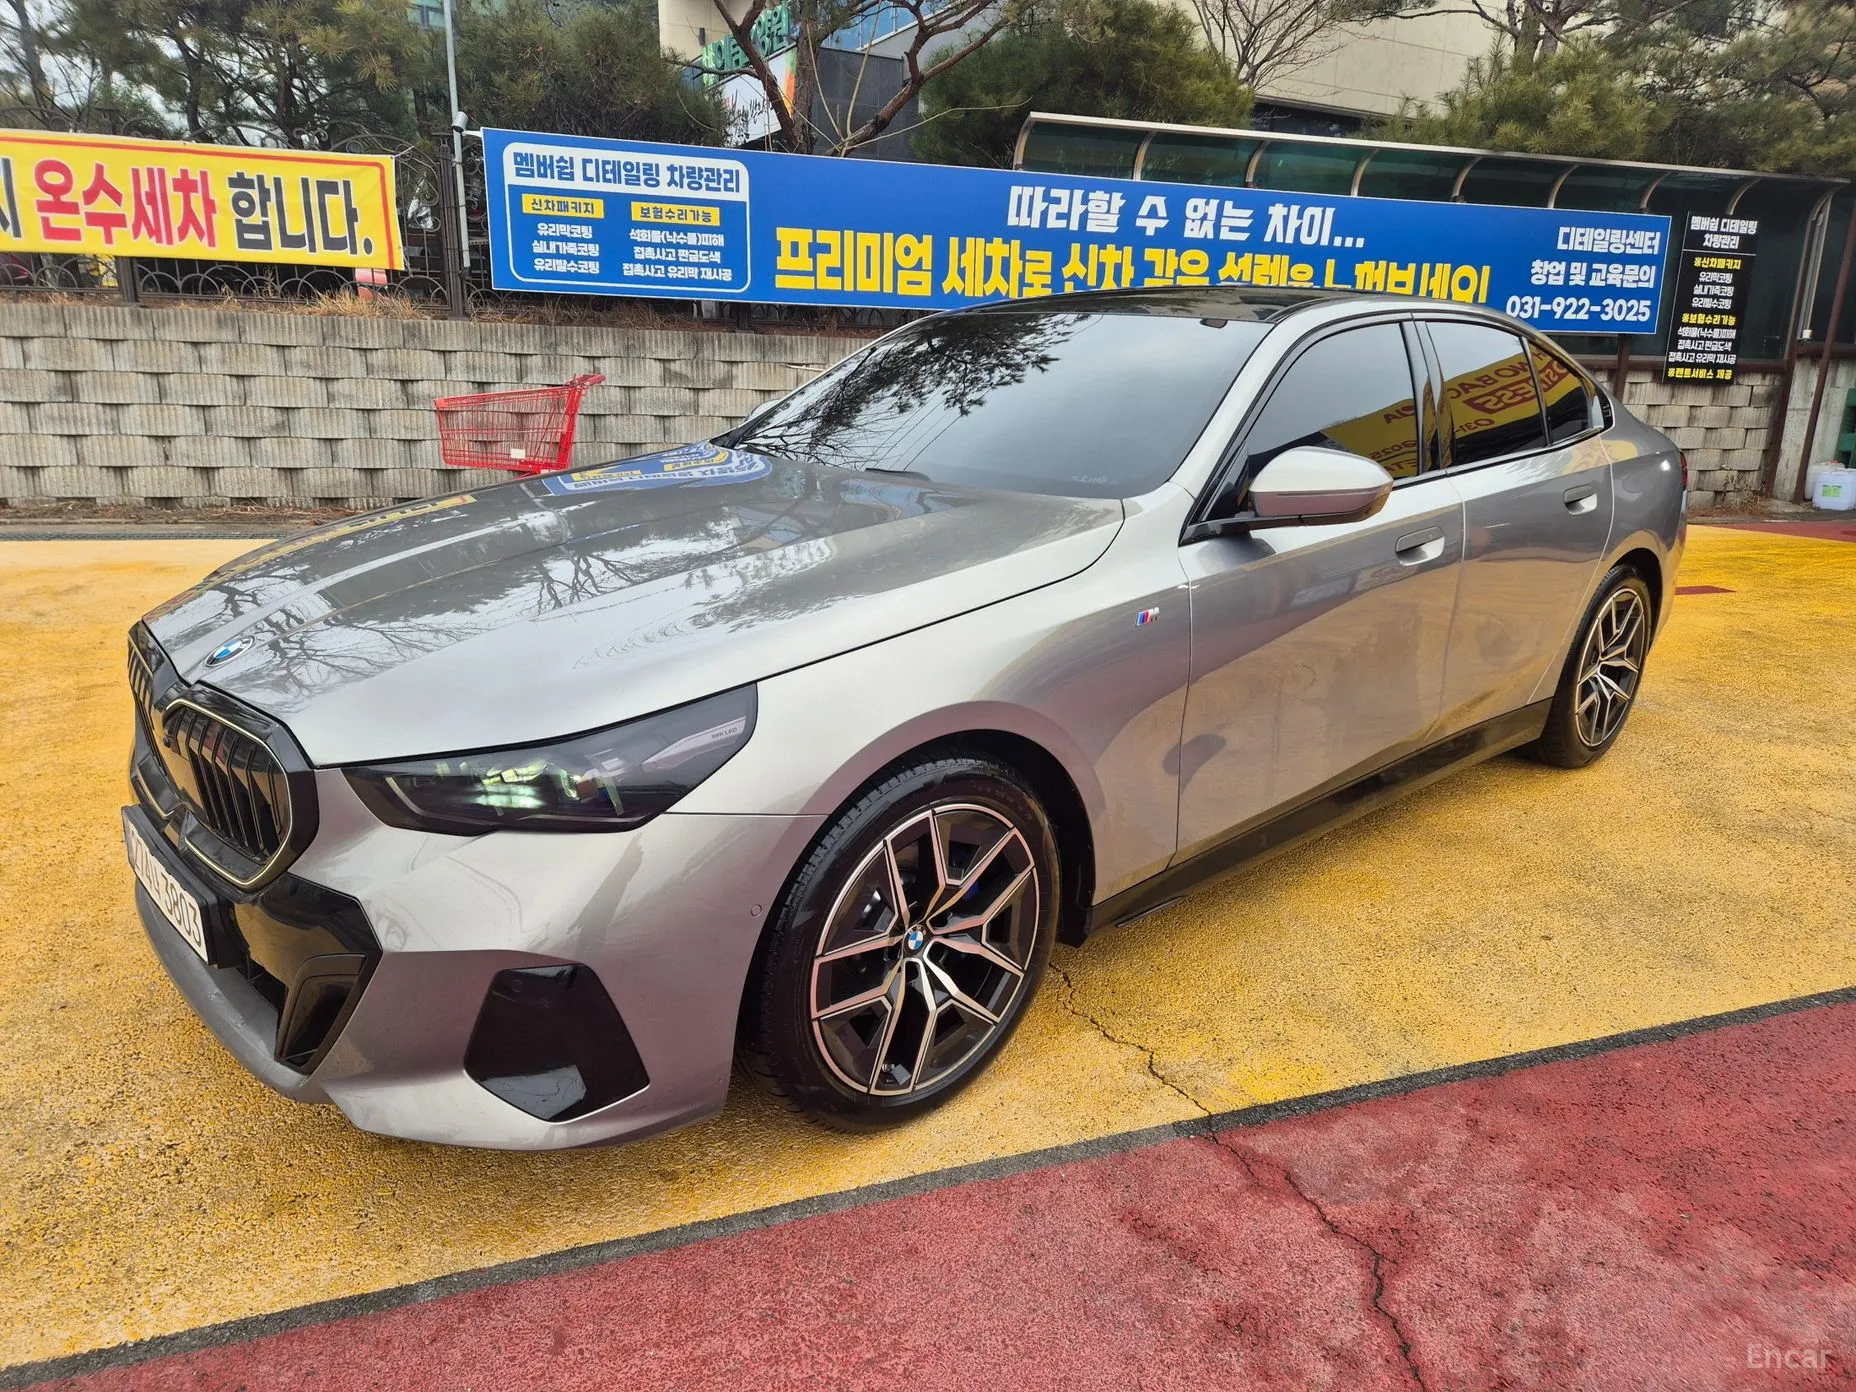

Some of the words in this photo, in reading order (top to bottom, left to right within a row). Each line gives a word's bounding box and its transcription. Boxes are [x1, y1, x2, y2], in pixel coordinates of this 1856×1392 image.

[513, 152, 575, 182] 멤버쉽
[582, 158, 660, 188] 디테일링
[666, 164, 740, 193] 차량관리
[34, 159, 218, 248] 온수세차
[227, 171, 374, 256] 합니다.
[531, 198, 594, 215] 신차패키지
[640, 206, 712, 223] 보험수리가능
[1007, 185, 1126, 233] 따라할
[1135, 196, 1169, 236] 수
[1184, 198, 1257, 241] 없는
[1264, 203, 1365, 248] 차이...
[537, 222, 593, 239] 유리막코팅
[1690, 216, 1720, 232] 멤버쉽
[1720, 218, 1758, 234] 디테일링
[531, 240, 600, 257] 실내가죽코팅
[1557, 226, 1661, 255] 디테일링센터
[1703, 233, 1740, 249] 차량관리
[633, 246, 677, 261] 접촉사고
[677, 249, 721, 264] 판금도색
[775, 227, 933, 296] 프리미엄
[942, 236, 1052, 298] 세차로
[622, 263, 665, 278] 접촉사고
[667, 266, 698, 280] 유리막
[701, 268, 732, 281] 재시공
[1531, 259, 1566, 286] 창업
[1569, 262, 1587, 286] 및
[1589, 263, 1656, 288] 교육문의
[1506, 295, 1651, 322] 031-922-3025
[161, 871, 201, 948] 3803
